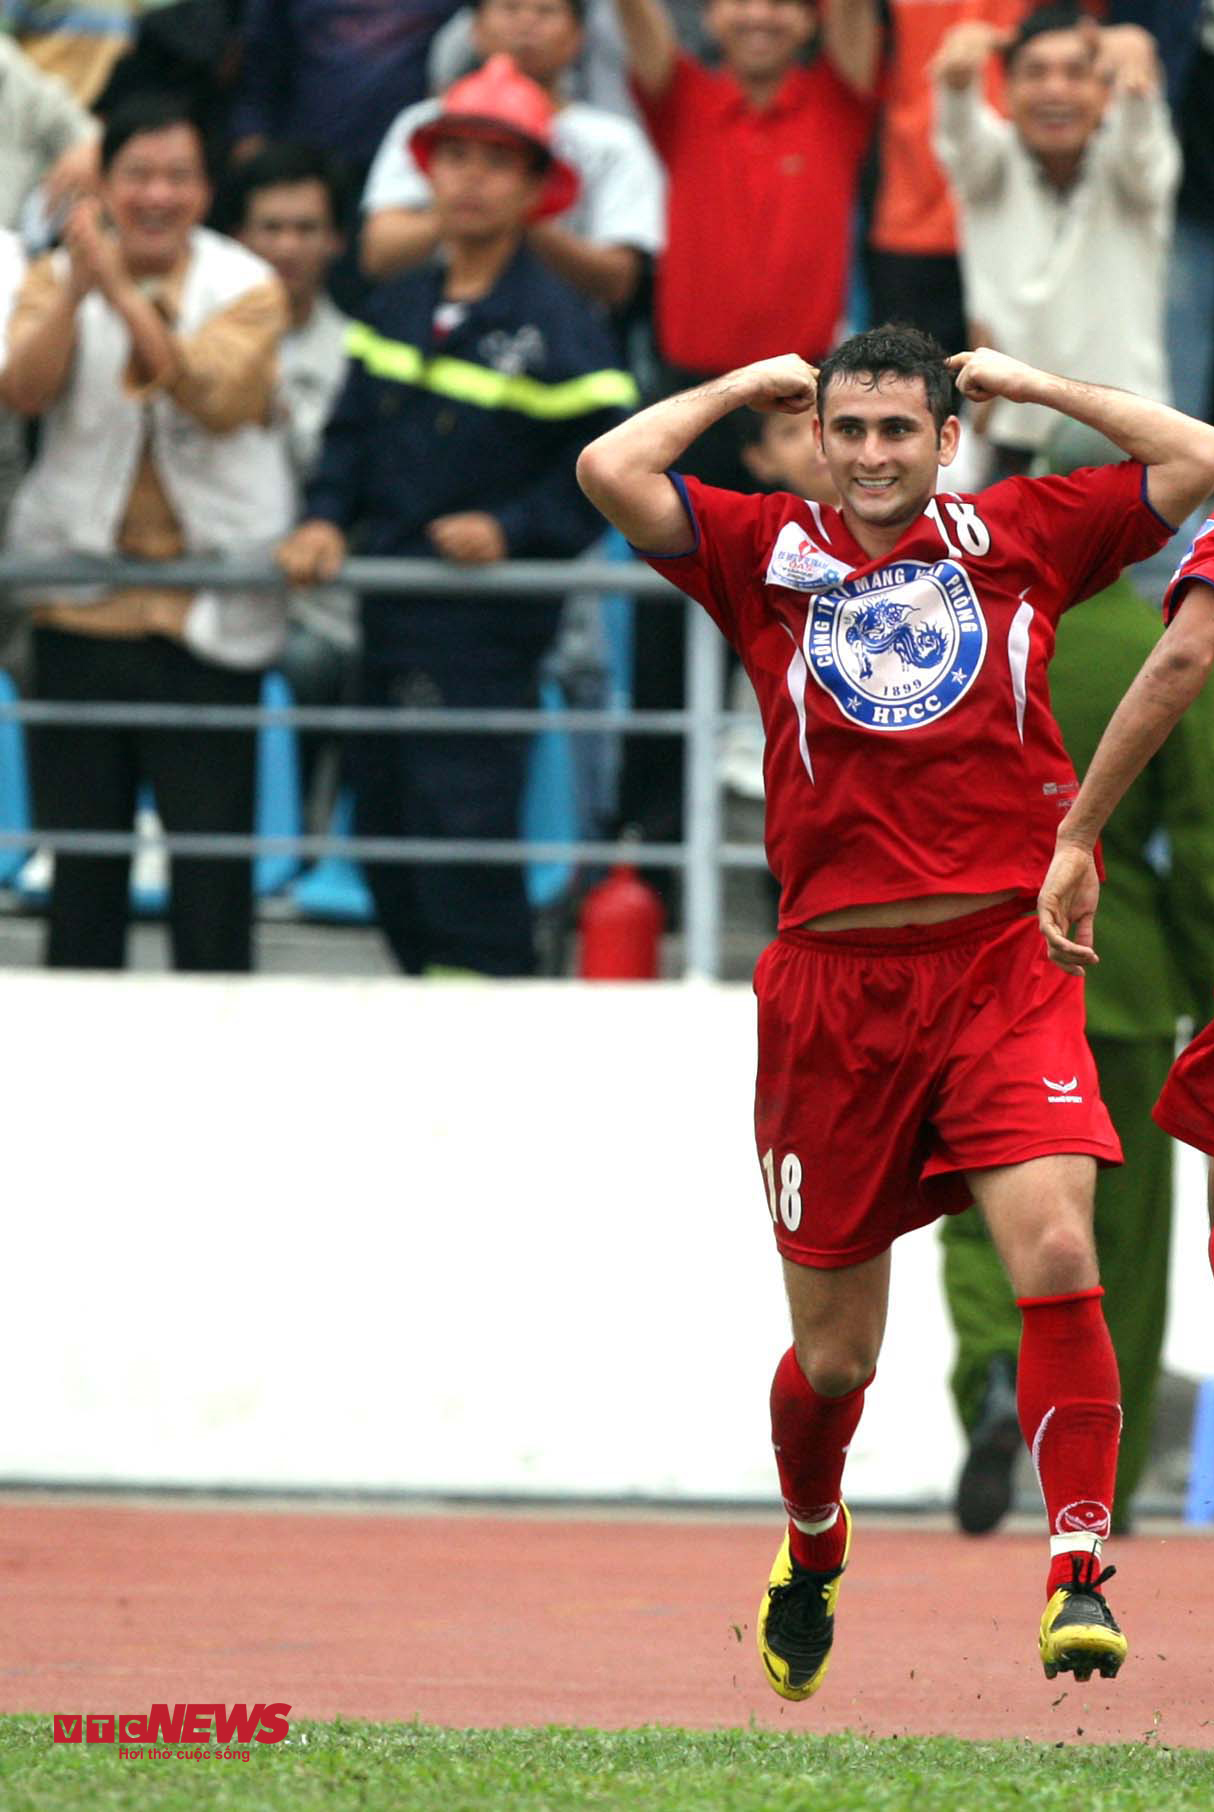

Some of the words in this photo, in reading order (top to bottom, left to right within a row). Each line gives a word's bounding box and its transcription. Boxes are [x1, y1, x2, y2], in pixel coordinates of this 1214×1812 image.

[922, 493, 991, 558] 18
[817, 596, 835, 615] TY
[883, 679, 922, 696] 1899
[872, 695, 942, 724] HPCC
[762, 1148, 803, 1232] 18
